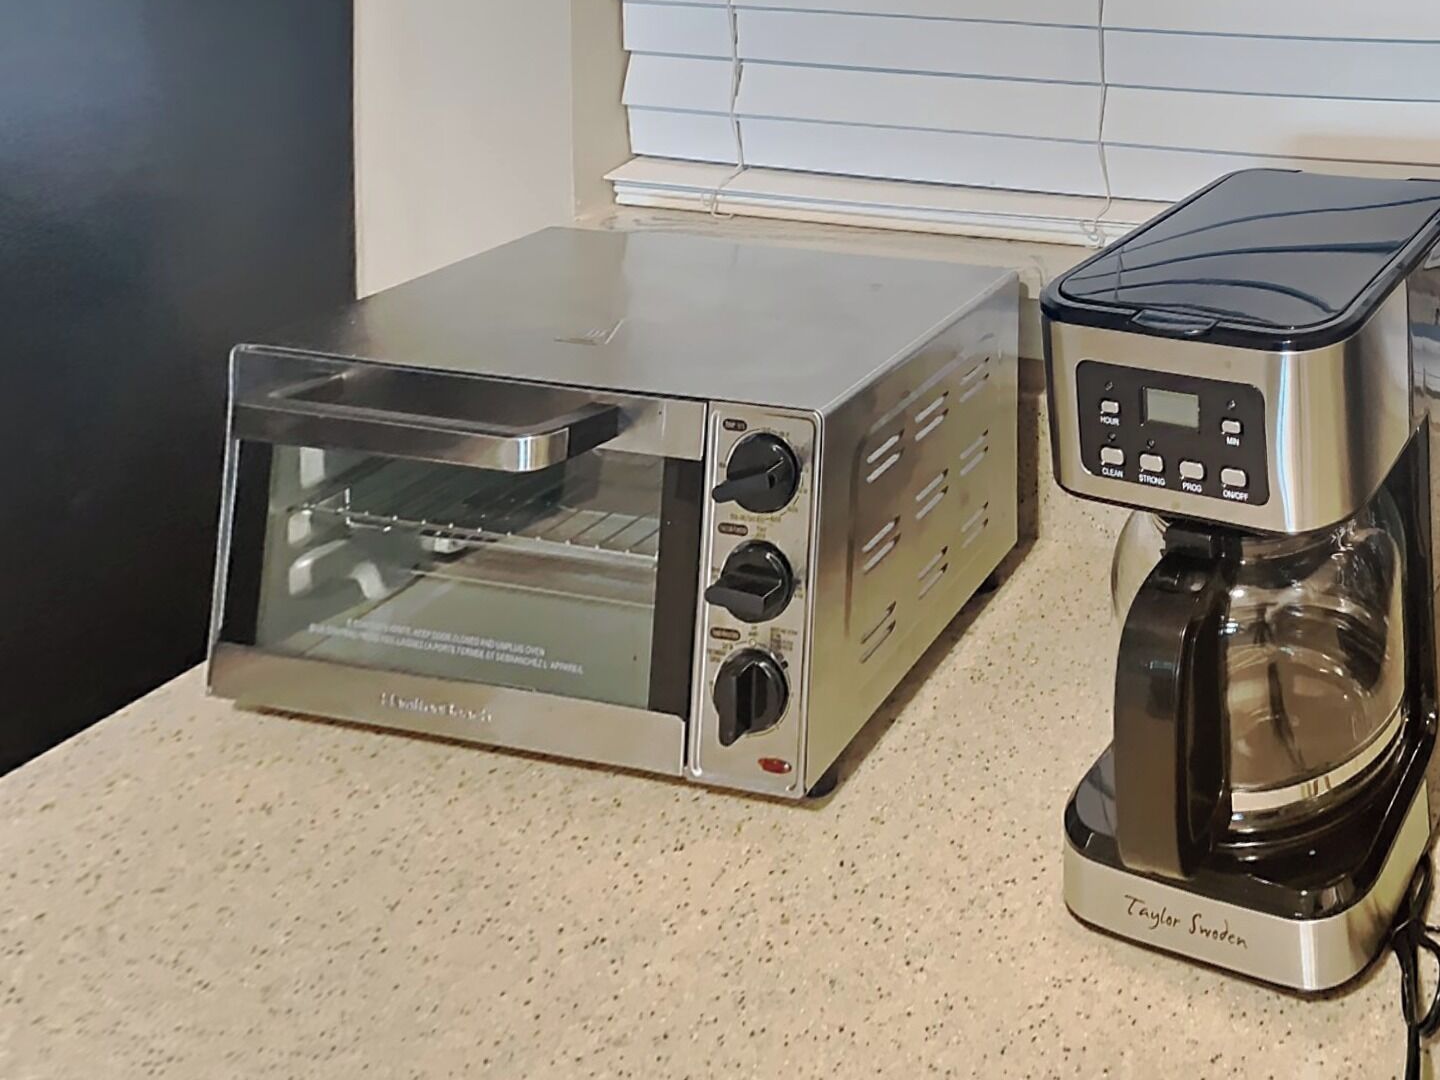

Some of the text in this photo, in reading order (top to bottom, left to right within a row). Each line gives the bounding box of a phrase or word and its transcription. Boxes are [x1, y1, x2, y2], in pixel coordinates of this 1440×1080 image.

[1100, 415, 1120, 427] HOUR
[1226, 436, 1240, 447] MIN
[1101, 467, 1124, 479] CLEAN
[1139, 473, 1166, 487] STRONG
[1182, 481, 1203, 494] PROG
[1222, 489, 1249, 502] ON/OFF
[1124, 894, 1249, 950] Taylor Swoden
